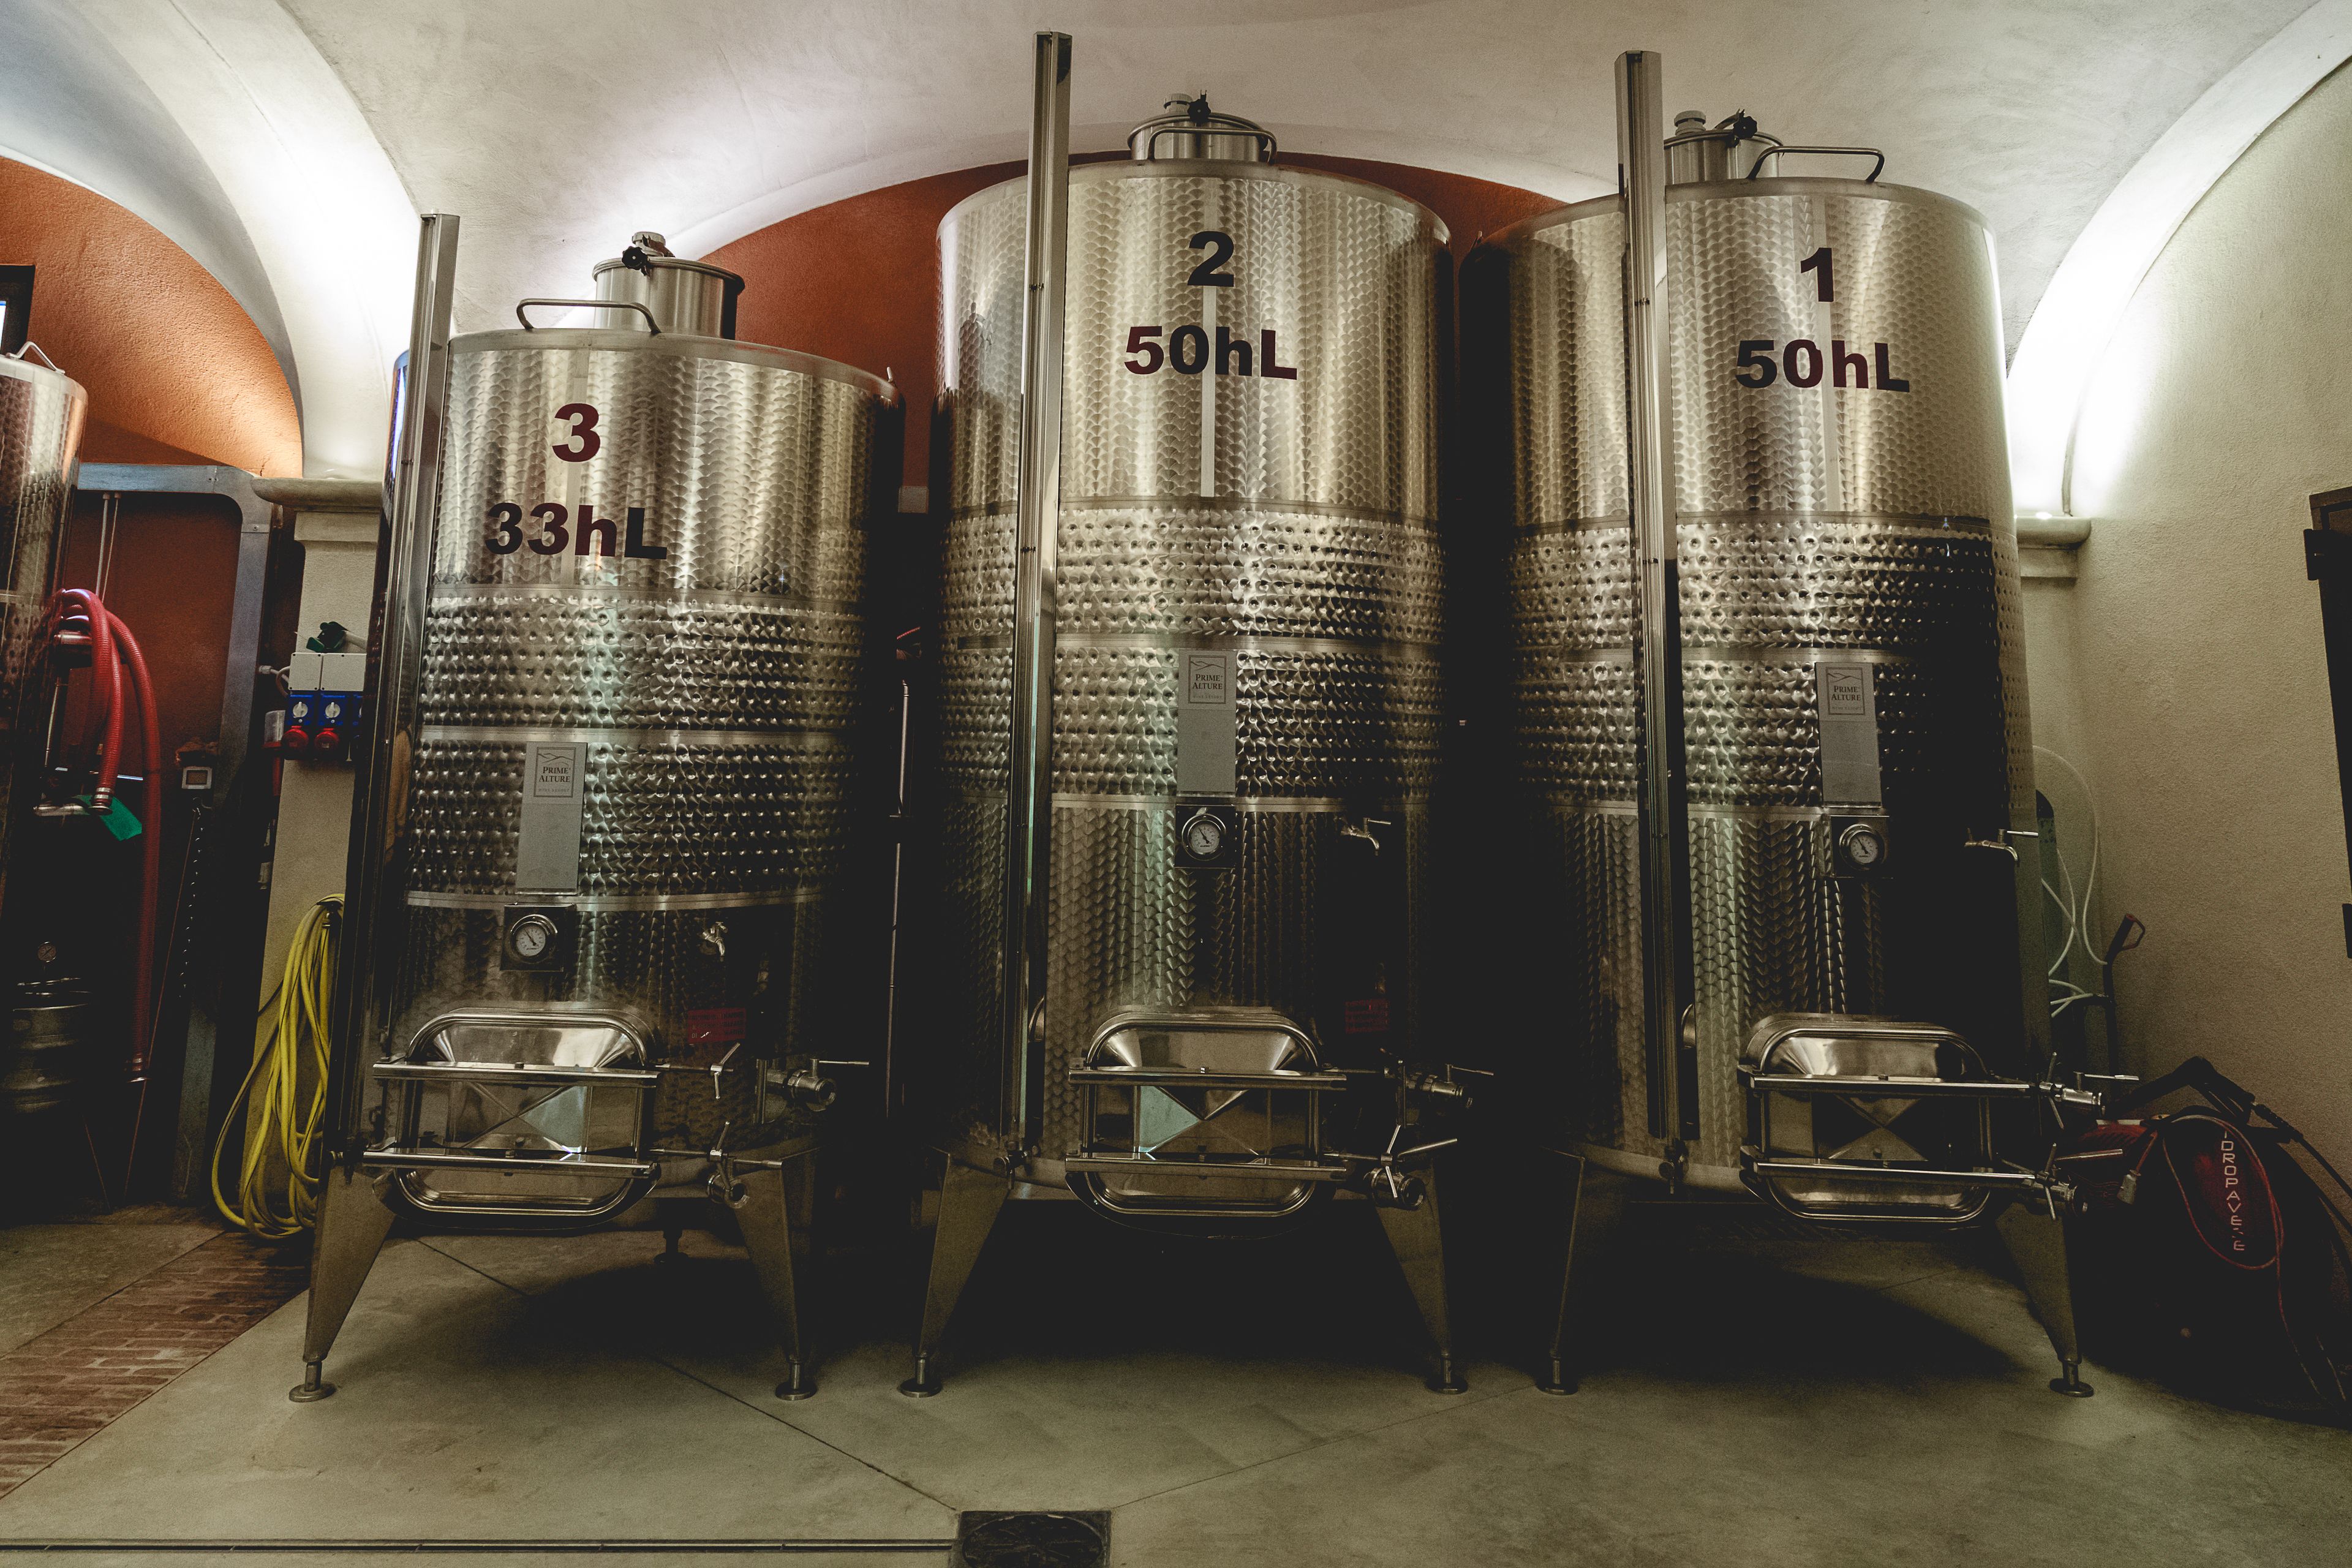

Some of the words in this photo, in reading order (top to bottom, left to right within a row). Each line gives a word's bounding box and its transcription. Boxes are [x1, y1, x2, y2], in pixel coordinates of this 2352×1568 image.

[1188, 230, 1234, 287] 2
[1800, 247, 1834, 303] 1
[1124, 325, 1297, 380] 50hL
[1735, 339, 1910, 393] 50hL
[552, 403, 601, 462] 3
[484, 502, 668, 560] 33hL
